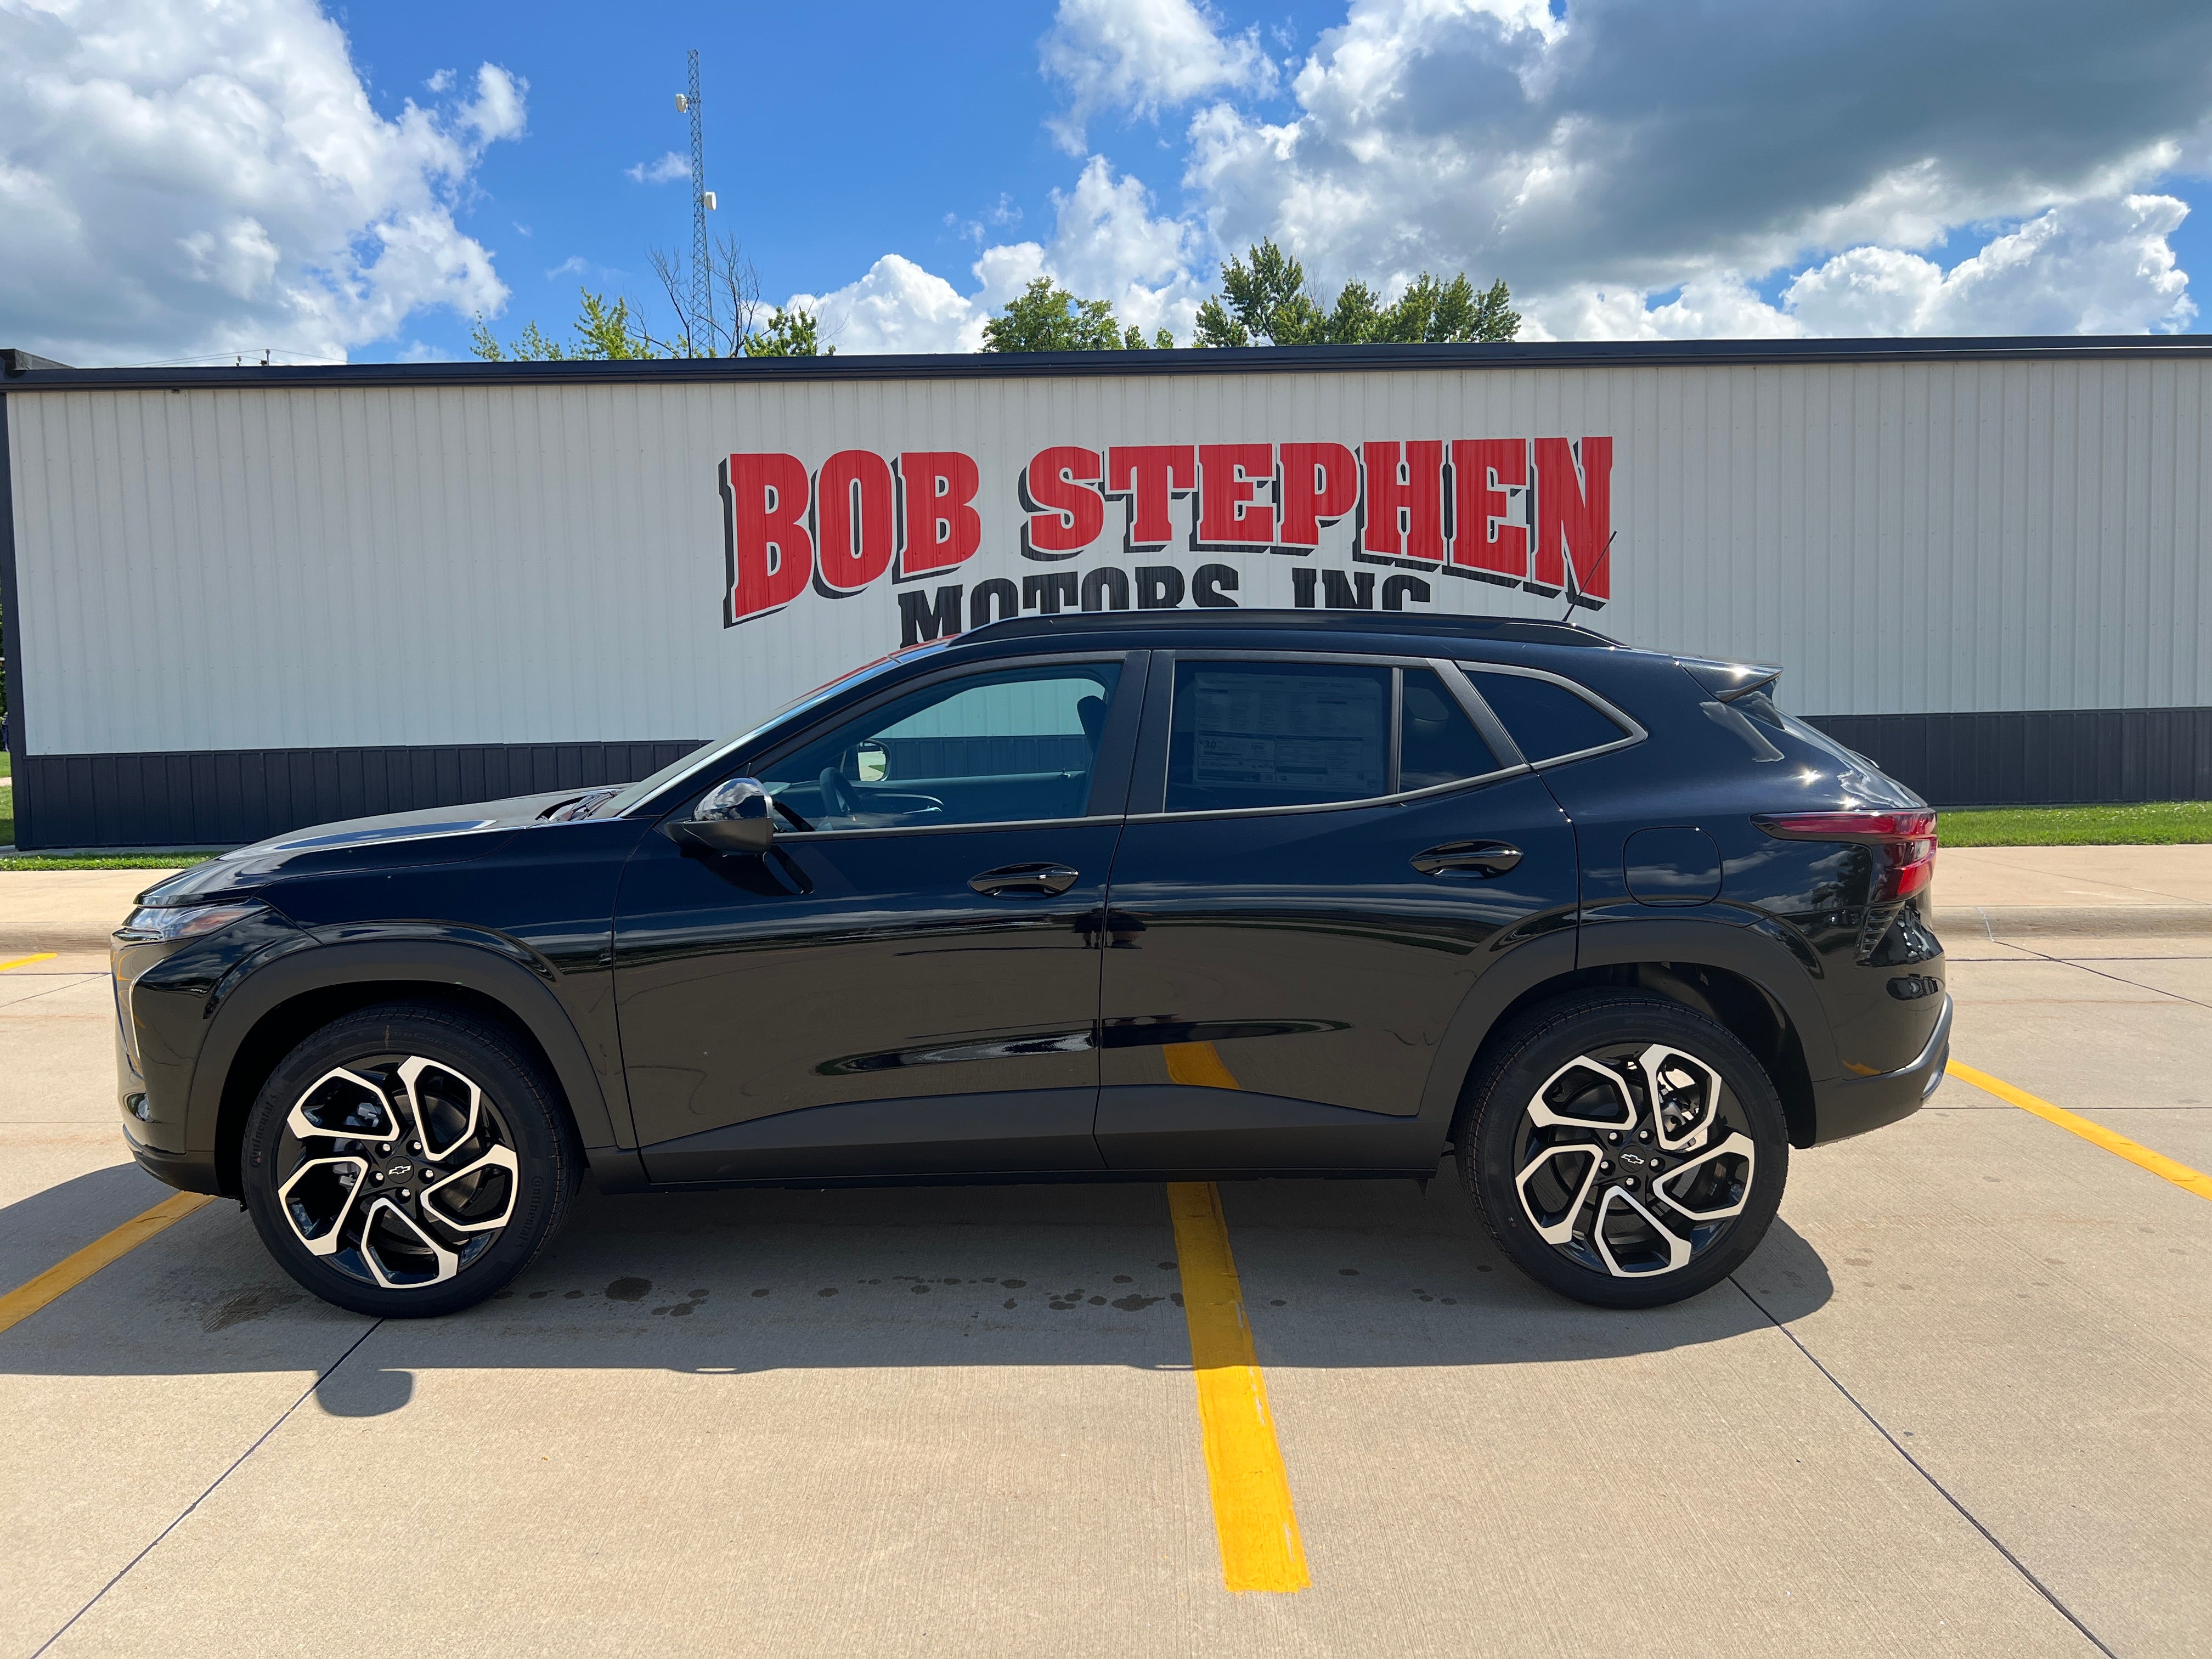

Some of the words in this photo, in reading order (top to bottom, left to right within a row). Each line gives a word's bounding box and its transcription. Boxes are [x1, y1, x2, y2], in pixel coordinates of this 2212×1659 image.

[719, 450, 981, 629] BOB
[1019, 436, 1615, 612] STEPHEN
[898, 564, 1239, 649] MOTORS
[518, 1175, 544, 1241] Continental
